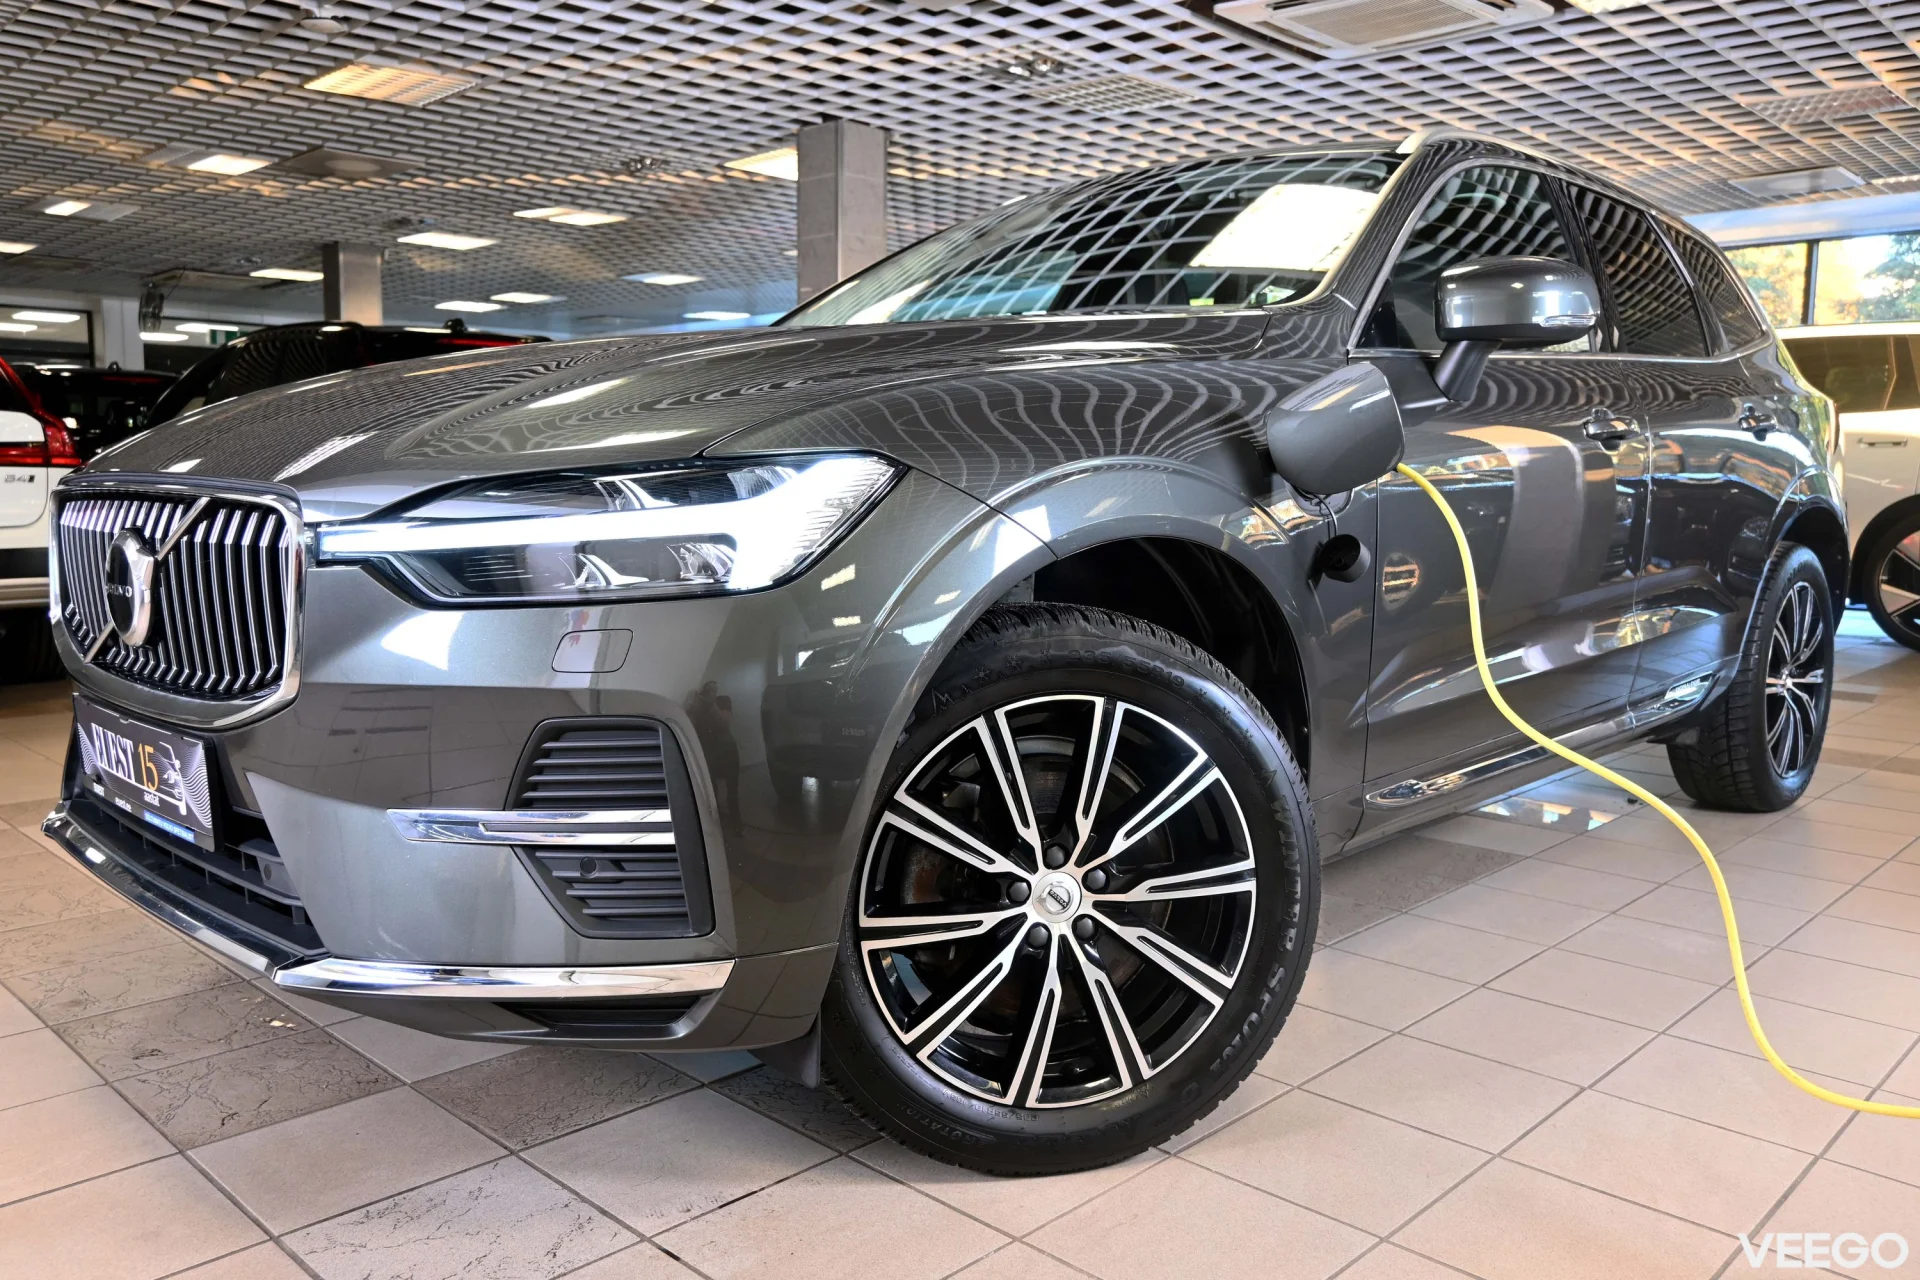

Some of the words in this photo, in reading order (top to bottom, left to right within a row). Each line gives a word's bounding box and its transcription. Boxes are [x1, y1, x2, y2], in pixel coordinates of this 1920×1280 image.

[138, 743, 159, 791] 15
[1270, 794, 1302, 952] WINTER
[1209, 962, 1288, 1075] SPORT
